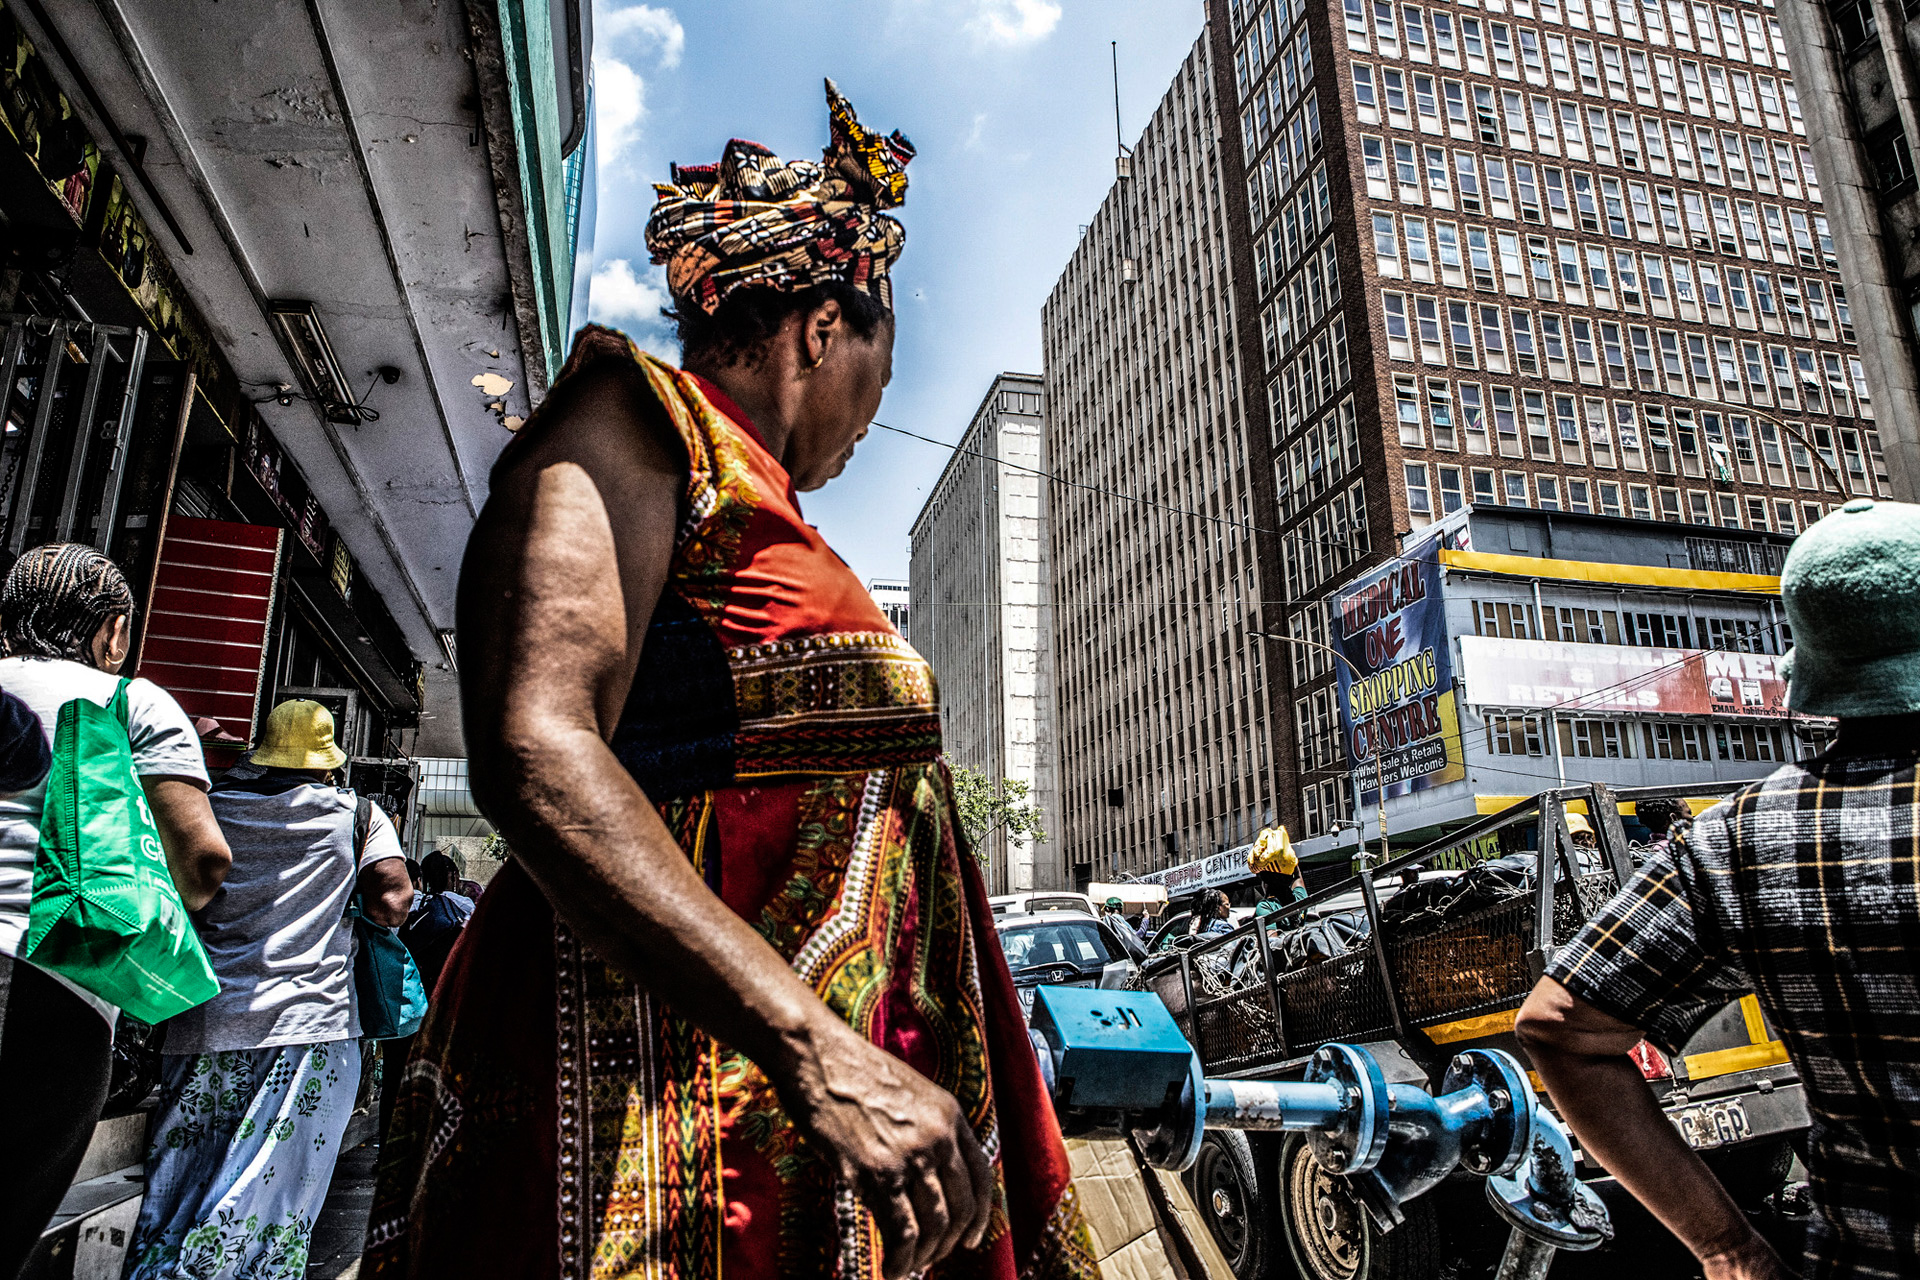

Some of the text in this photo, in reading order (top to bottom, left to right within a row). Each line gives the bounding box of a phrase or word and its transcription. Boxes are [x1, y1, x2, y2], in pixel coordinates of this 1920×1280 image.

[1341, 559, 1426, 640] MEDICAL
[1366, 615, 1405, 668] ONE
[1705, 650, 1783, 681] ME
[1349, 646, 1438, 721] SHOPPING
[1507, 684, 1660, 707] RETAILS
[1711, 704, 1740, 714] EMAIL:
[1352, 691, 1442, 761] CENTRE
[1400, 757, 1444, 779] Welcome
[1402, 752, 1409, 764] &
[1411, 742, 1442, 760] Retails
[1205, 847, 1250, 877] CENTRE
[1714, 1107, 1744, 1143] GP
